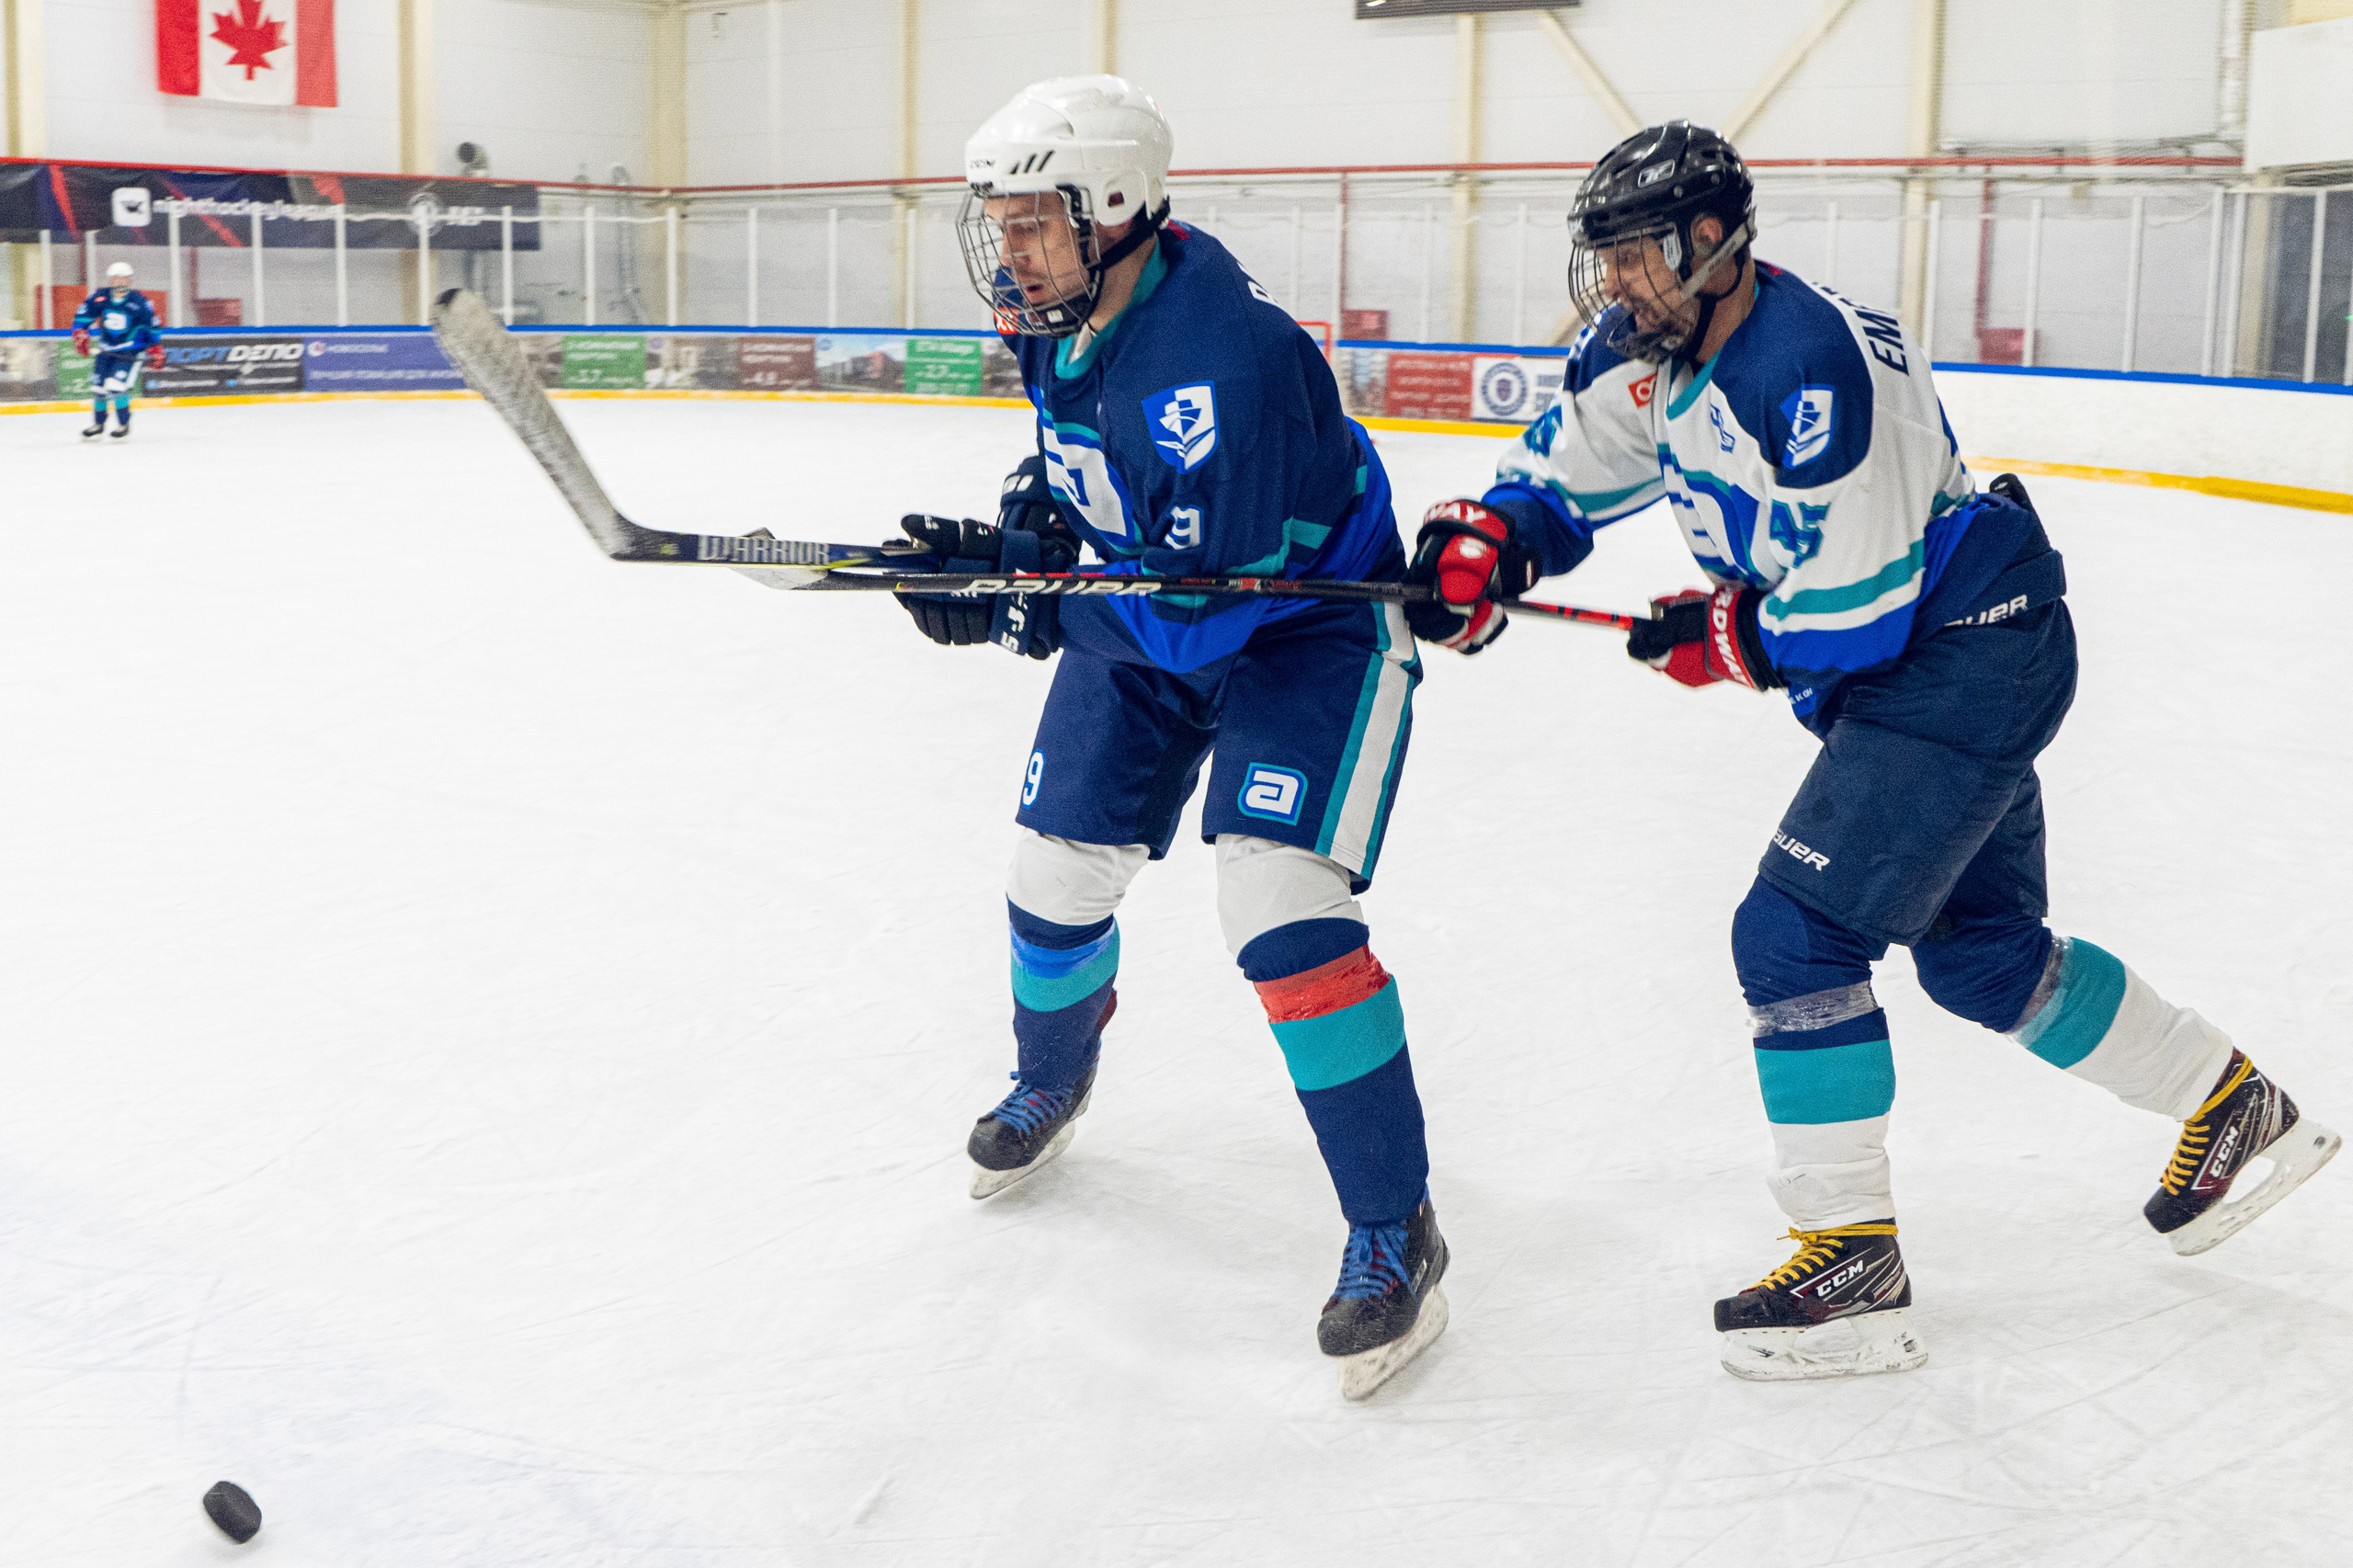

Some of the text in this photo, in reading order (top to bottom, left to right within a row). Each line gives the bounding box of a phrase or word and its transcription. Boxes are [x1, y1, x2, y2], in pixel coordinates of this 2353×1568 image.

[698, 535, 829, 565] WARRIOR
[1165, 506, 1201, 551] 9
[1769, 498, 1832, 569] 45
[1021, 750, 1044, 807] 9
[2208, 1126, 2240, 1178] CCM
[1814, 1259, 1865, 1298] CCM
